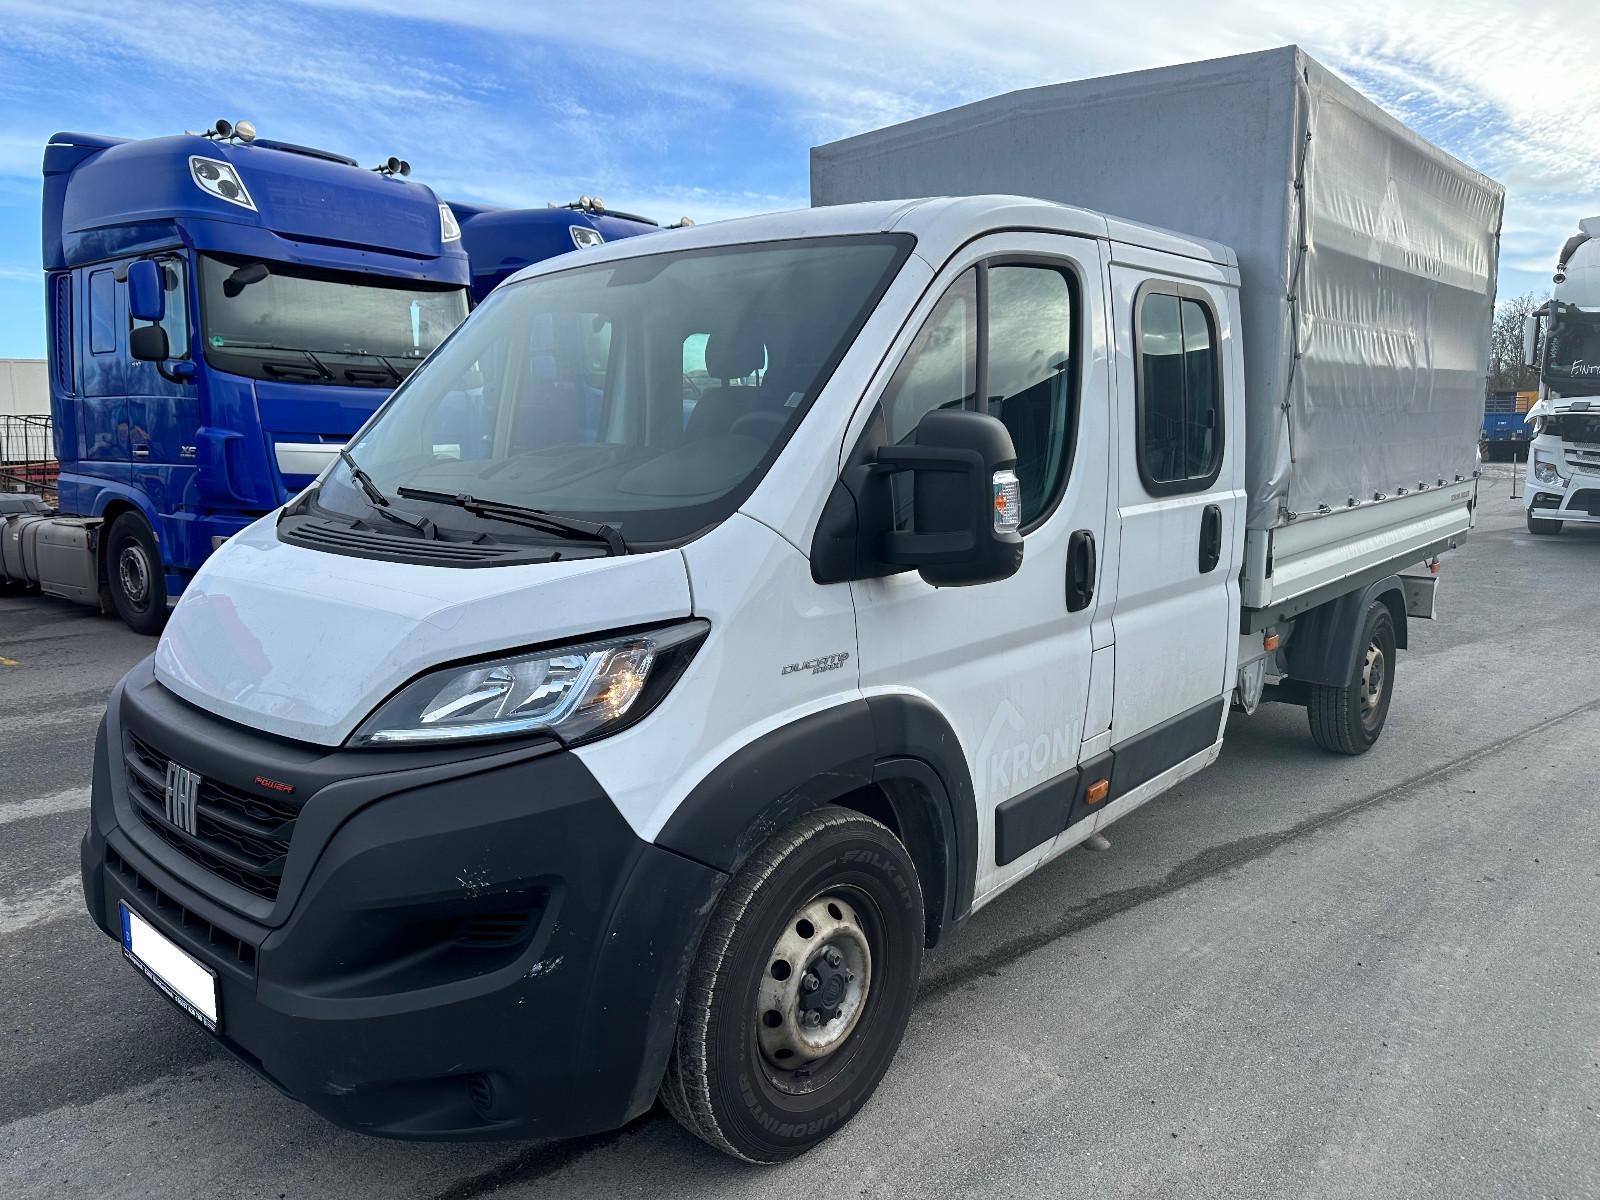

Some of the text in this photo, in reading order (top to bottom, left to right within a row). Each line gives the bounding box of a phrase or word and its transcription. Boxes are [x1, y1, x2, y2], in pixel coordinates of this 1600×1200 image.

[781, 651, 849, 675] DUCATO
[254, 775, 293, 793] POWER
[165, 761, 201, 836] FIAT
